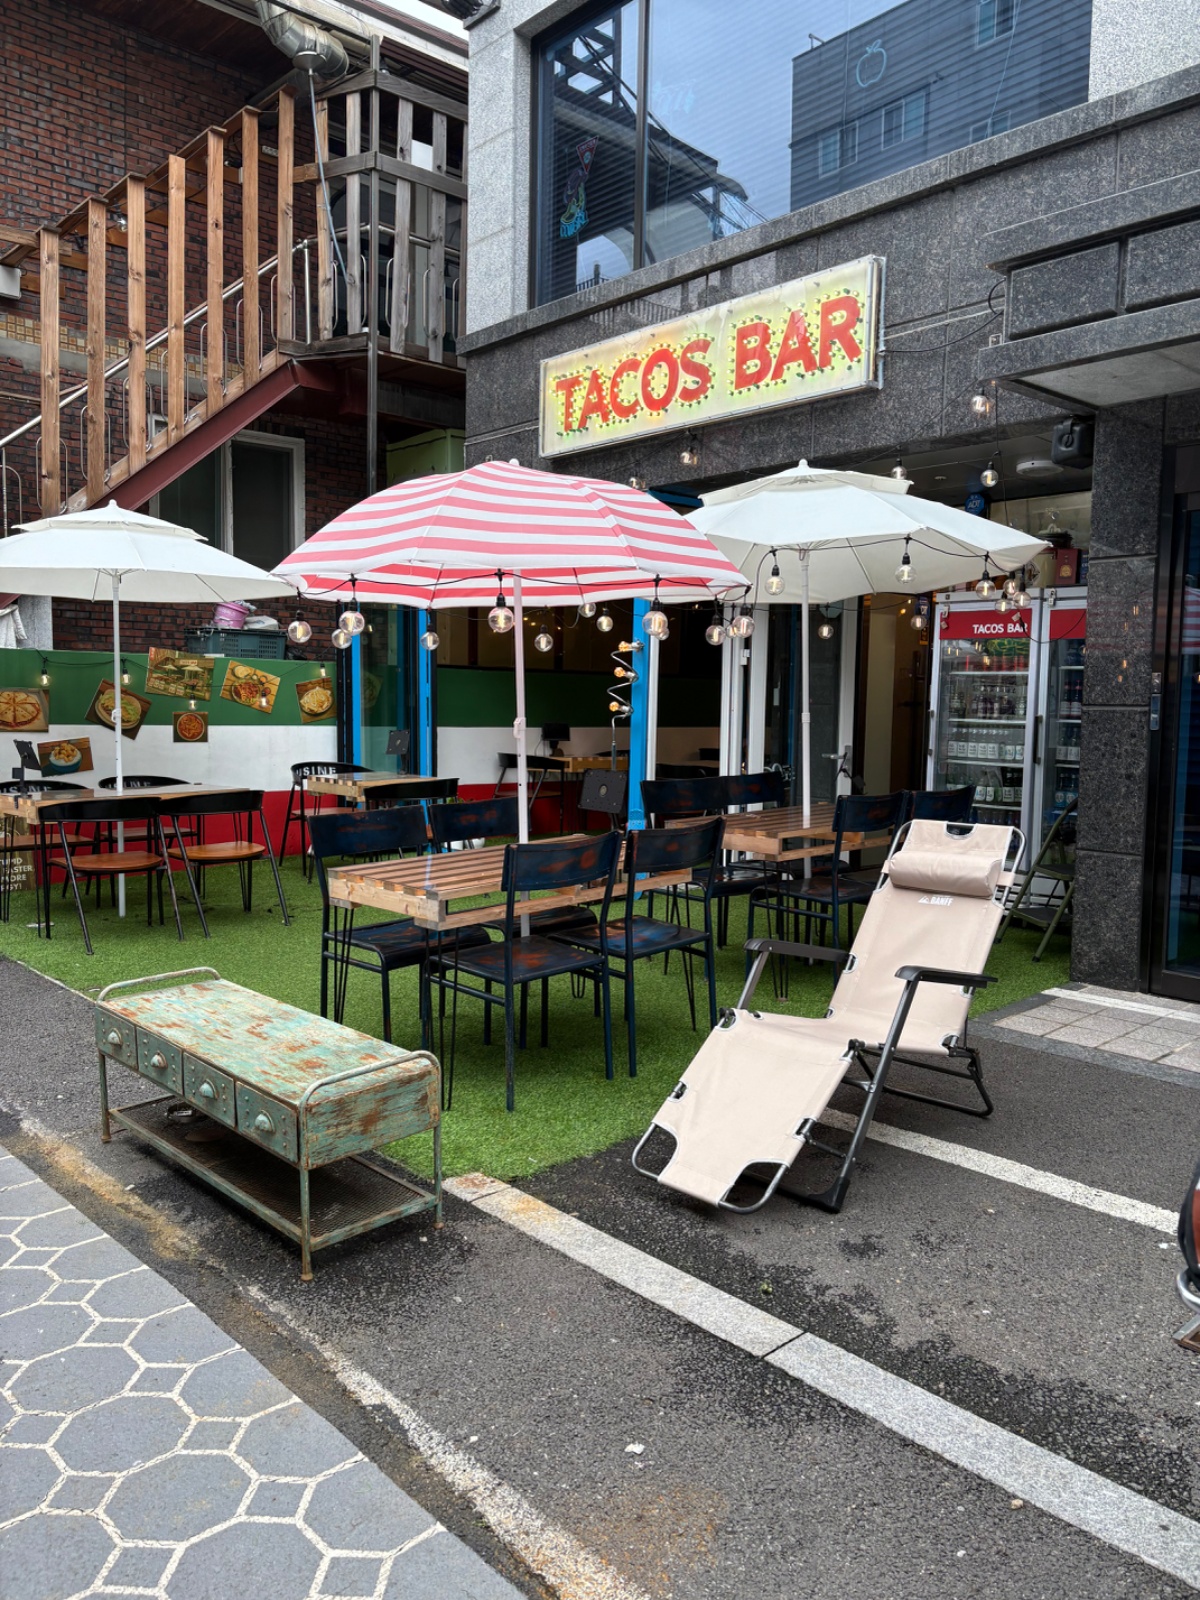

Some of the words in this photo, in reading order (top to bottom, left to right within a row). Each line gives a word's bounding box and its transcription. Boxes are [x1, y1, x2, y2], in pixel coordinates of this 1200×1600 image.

[555, 338, 713, 432] TACOS
[734, 295, 862, 390] BAR
[972, 623, 1005, 634] TACOS
[1007, 622, 1028, 633] BAR
